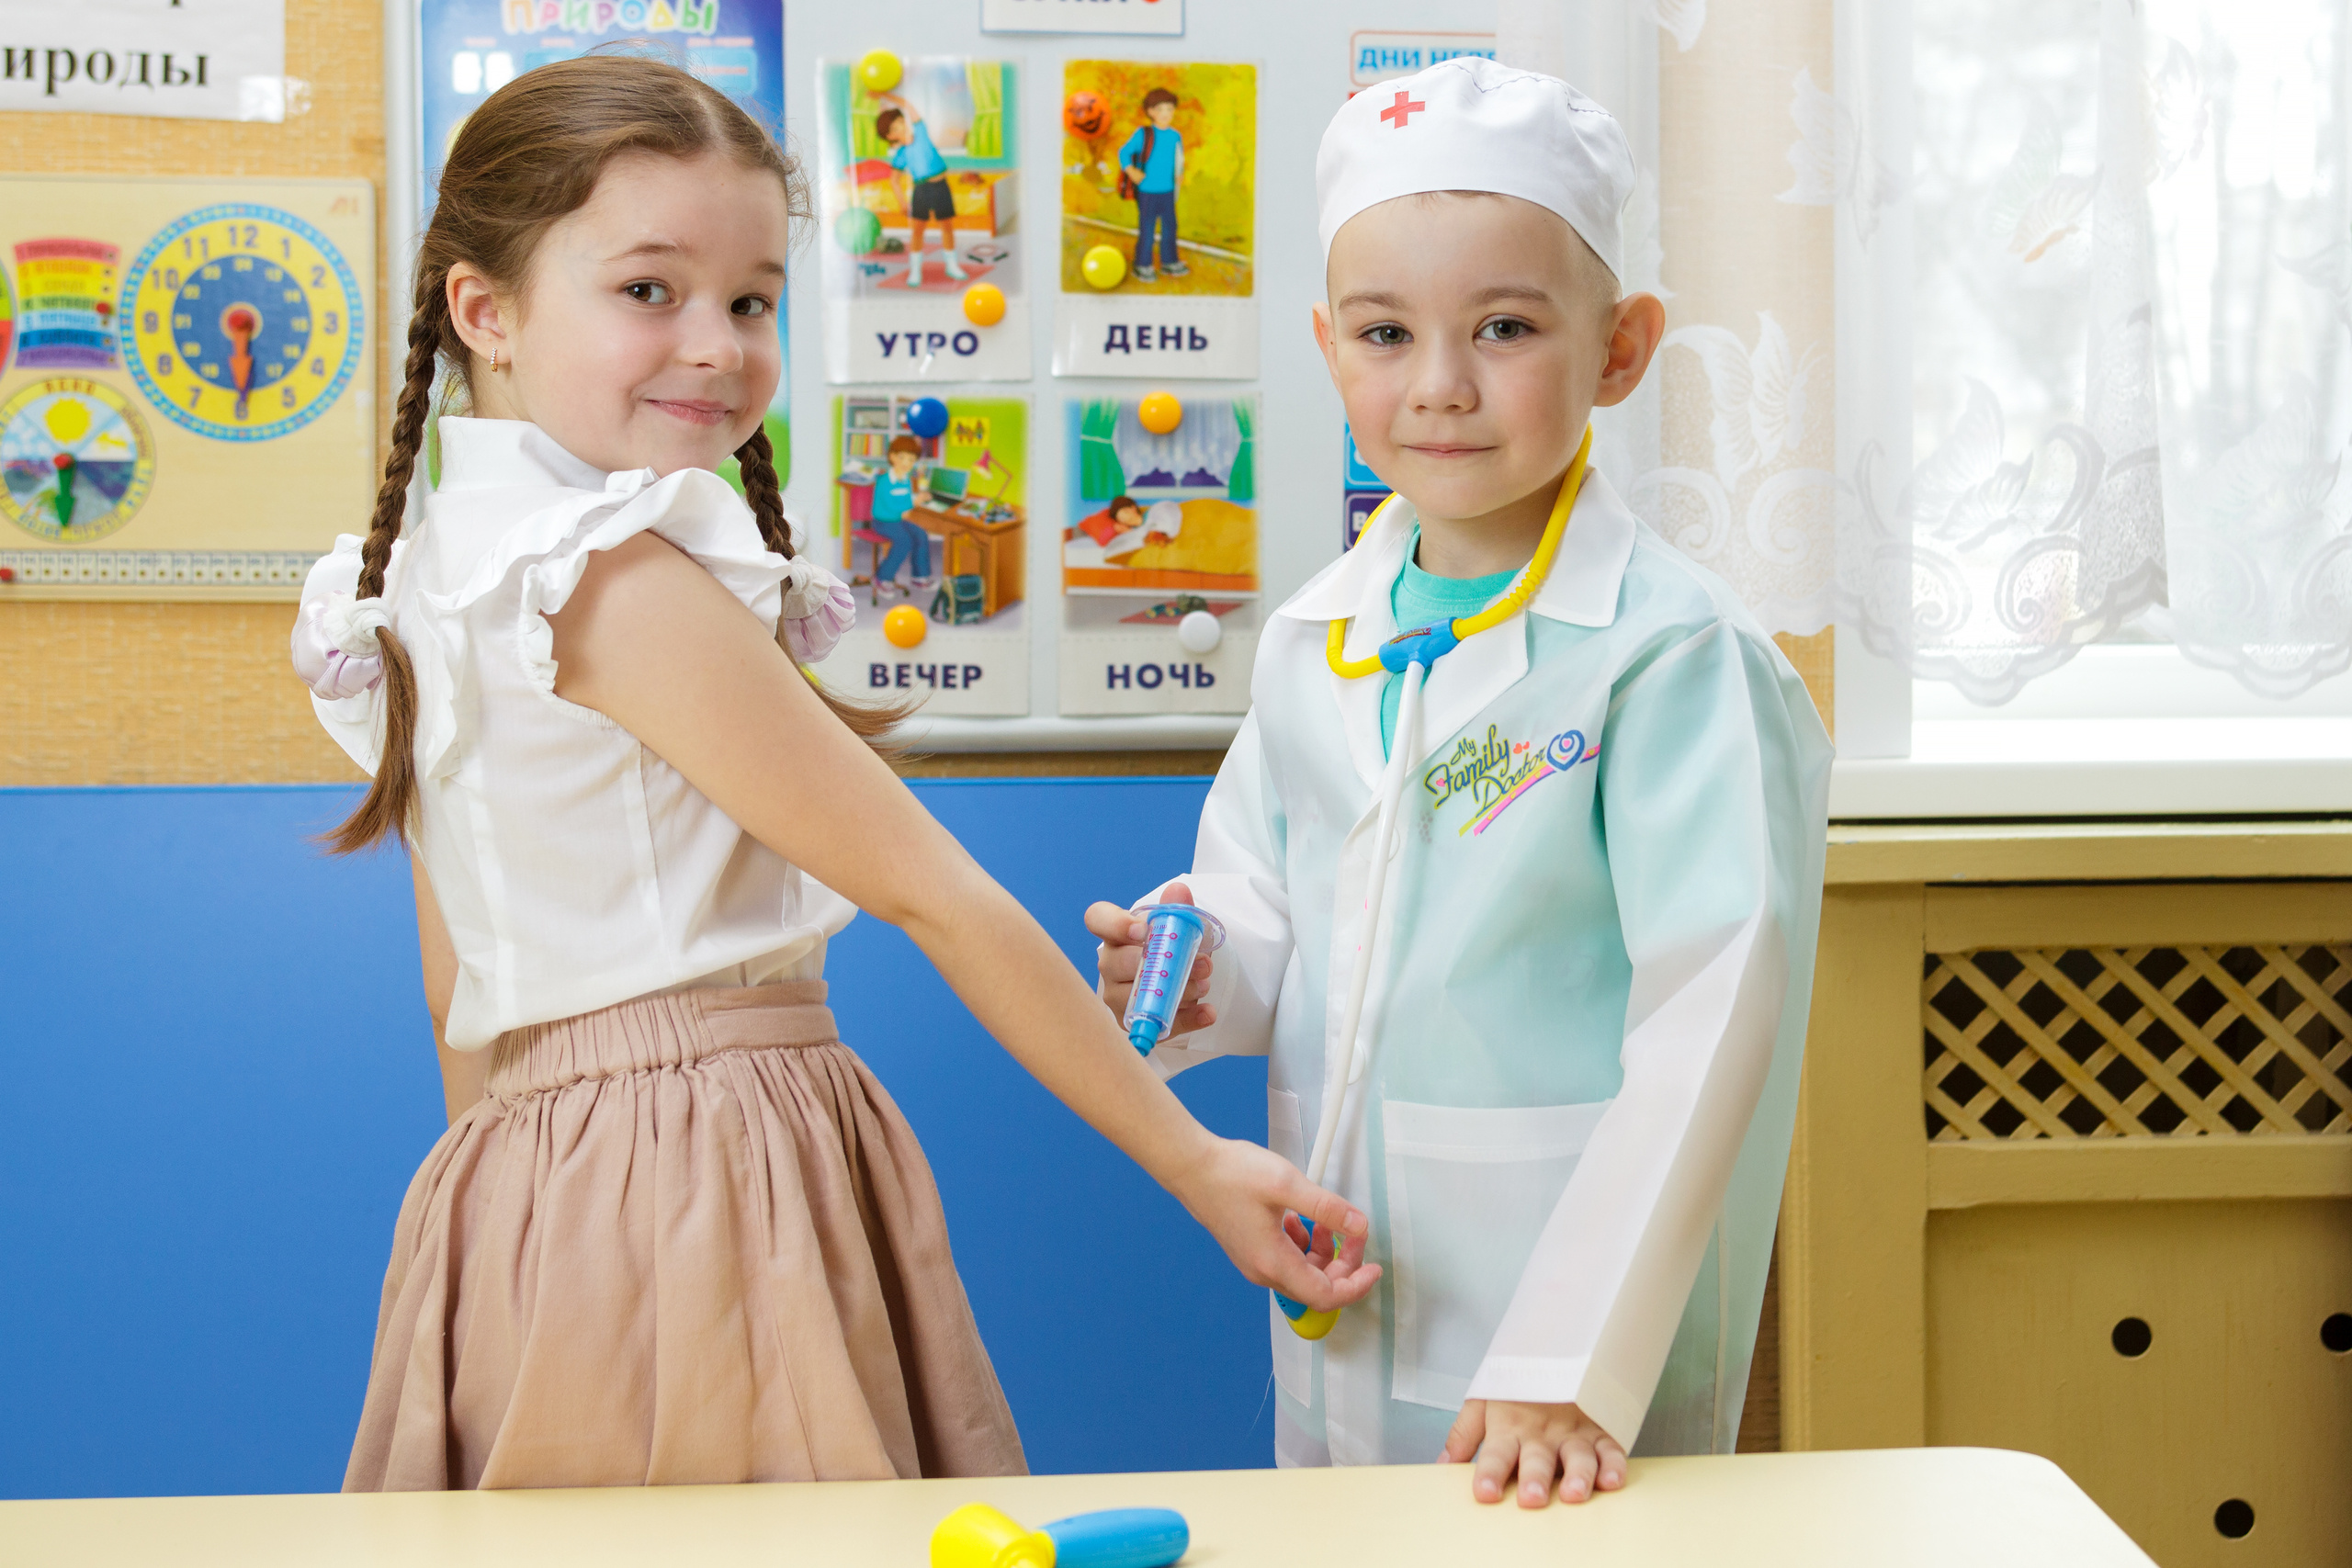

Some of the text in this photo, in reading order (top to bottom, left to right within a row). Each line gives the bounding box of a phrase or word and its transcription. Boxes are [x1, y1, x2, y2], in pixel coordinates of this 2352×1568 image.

[503, 0, 720, 35] ПРИРОДЫ
[2, 45, 210, 96] ироды
[1359, 48, 1420, 71] ДНИ
[184, 236, 209, 260] 11
[227, 224, 259, 248] 12
[281, 237, 291, 260] 1
[152, 268, 180, 291] 10
[311, 265, 326, 288] 2
[143, 310, 159, 334] 9
[323, 312, 339, 334] 3
[876, 330, 979, 358] УТРО
[1103, 323, 1209, 355] ДЕНЬ
[157, 353, 174, 377] 8
[311, 357, 325, 378] 4
[189, 386, 203, 409] 7
[281, 386, 296, 409] 5
[869, 662, 983, 690] ВЕЧЕР
[1106, 663, 1216, 690] НОЧЬ
[1450, 737, 1477, 765] My
[1425, 723, 1510, 808] Family
[1474, 745, 1548, 818] Doctor
